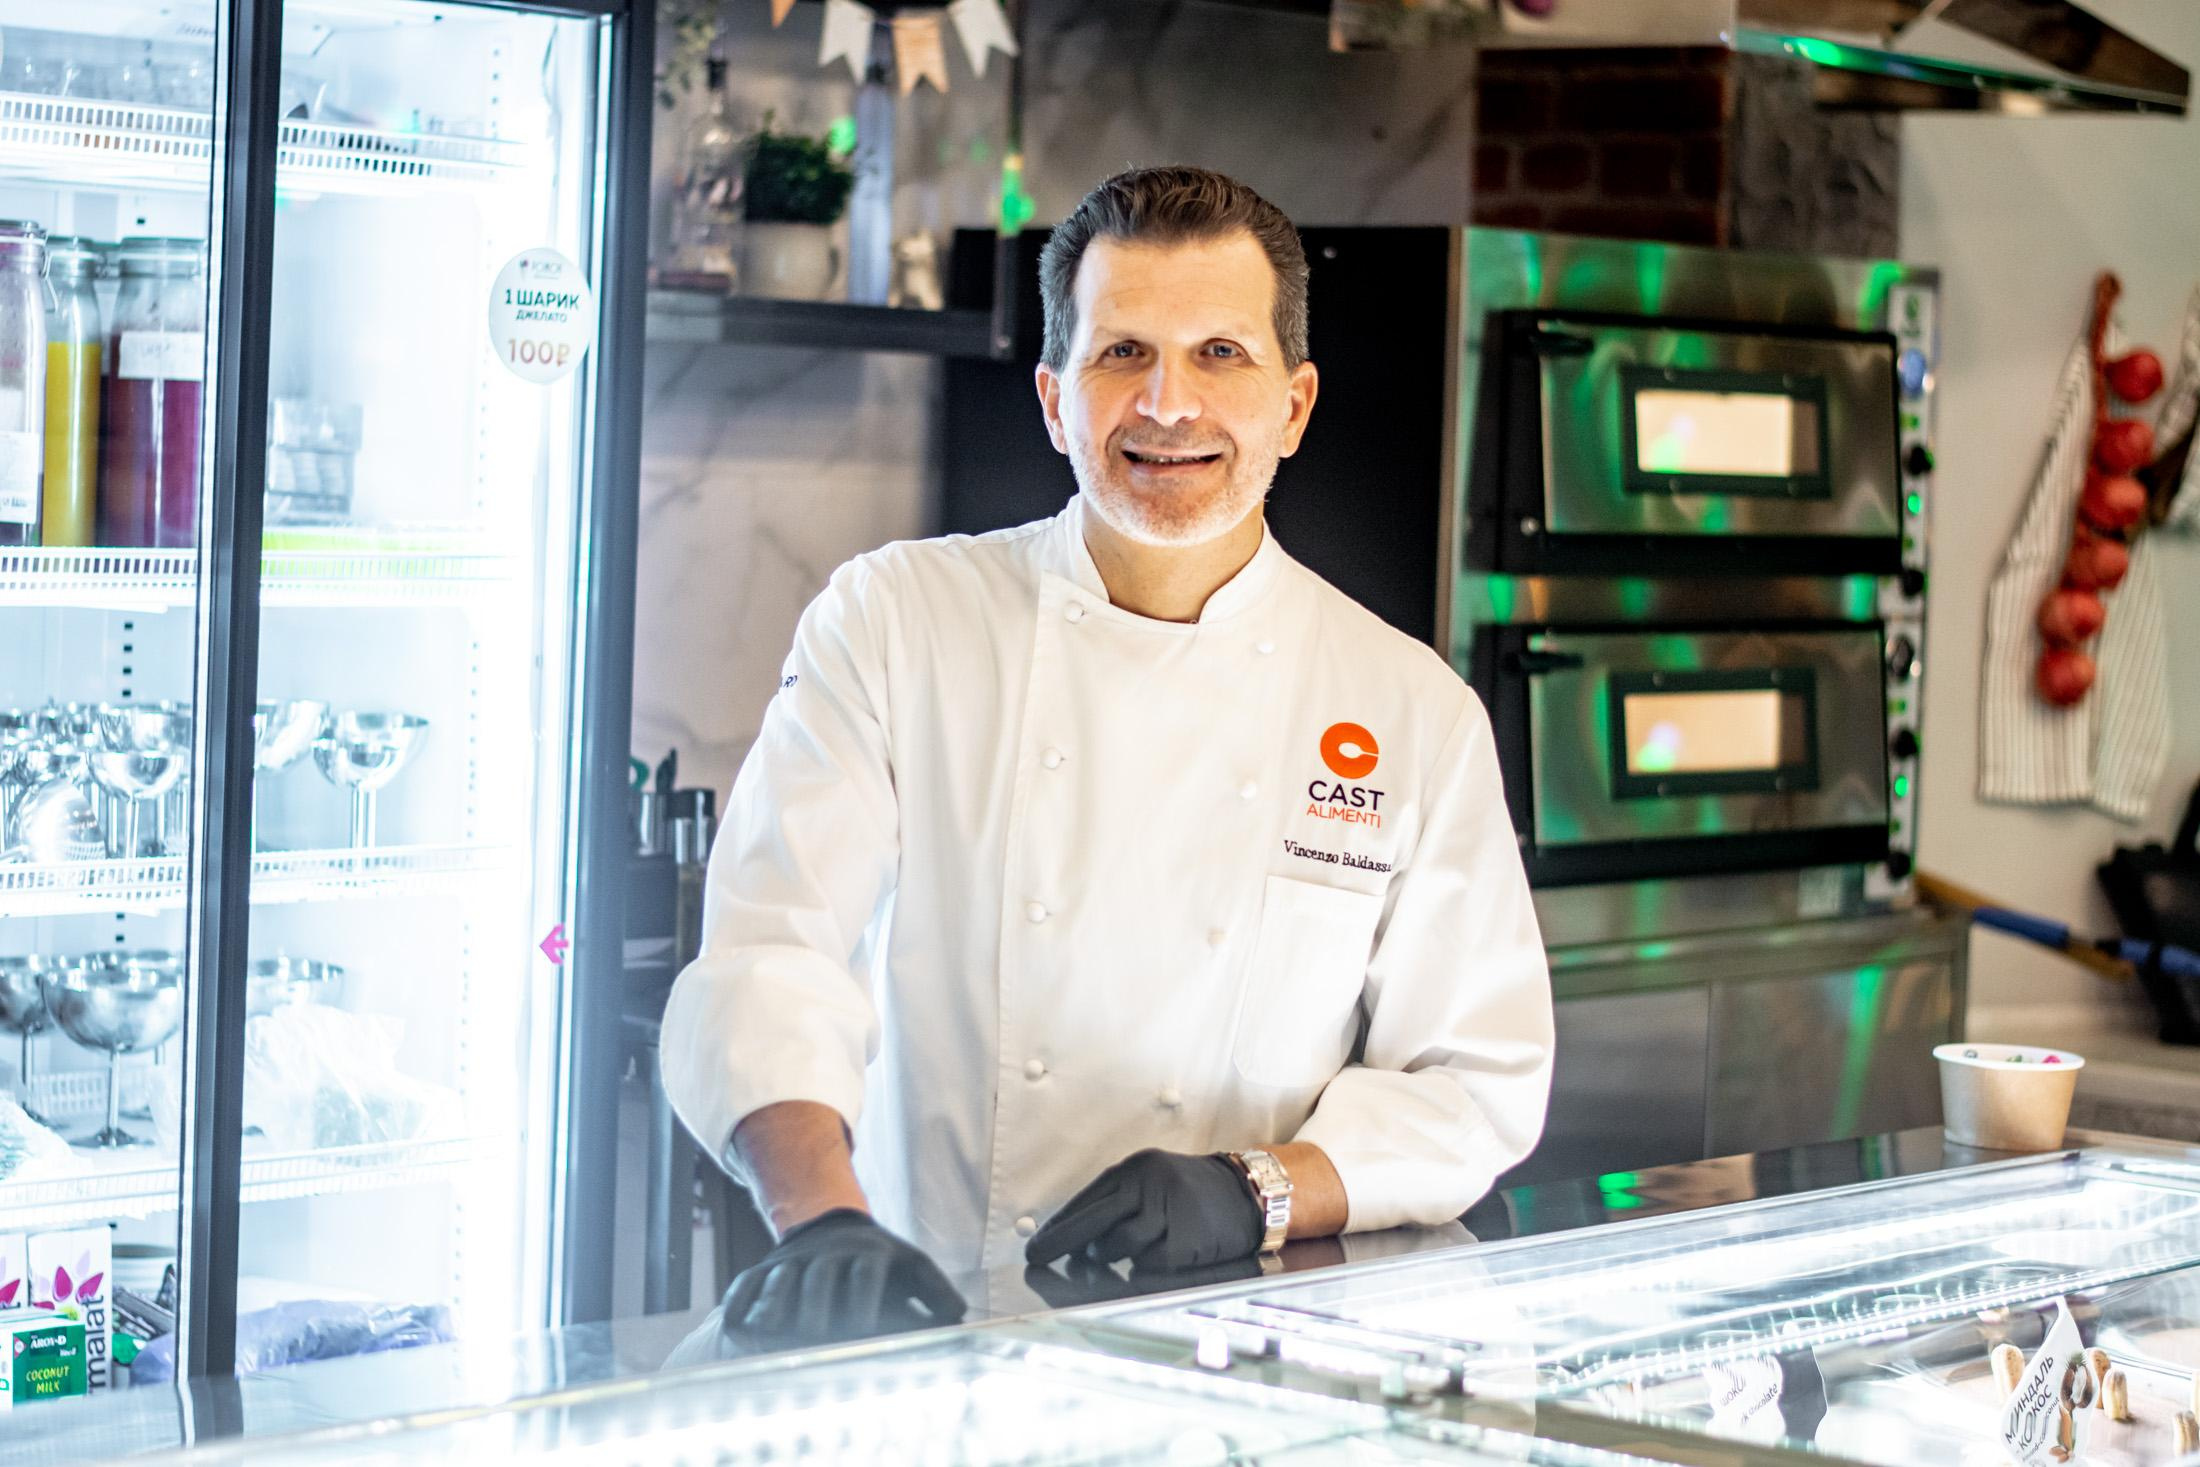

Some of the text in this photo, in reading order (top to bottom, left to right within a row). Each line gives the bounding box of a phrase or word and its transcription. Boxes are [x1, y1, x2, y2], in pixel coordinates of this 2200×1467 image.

[505, 288, 579, 310] 1 ШАРИК
[515, 309, 567, 323] ДЖЕЛАТО
[1308, 780, 1385, 811] CAST
[1306, 803, 1381, 828] ALIMENTI
[1284, 839, 1339, 864] Vincenzo
[81, 1294, 106, 1394] malat
[26, 1365, 70, 1382] COCONUT
[36, 1380, 60, 1394] MILK
